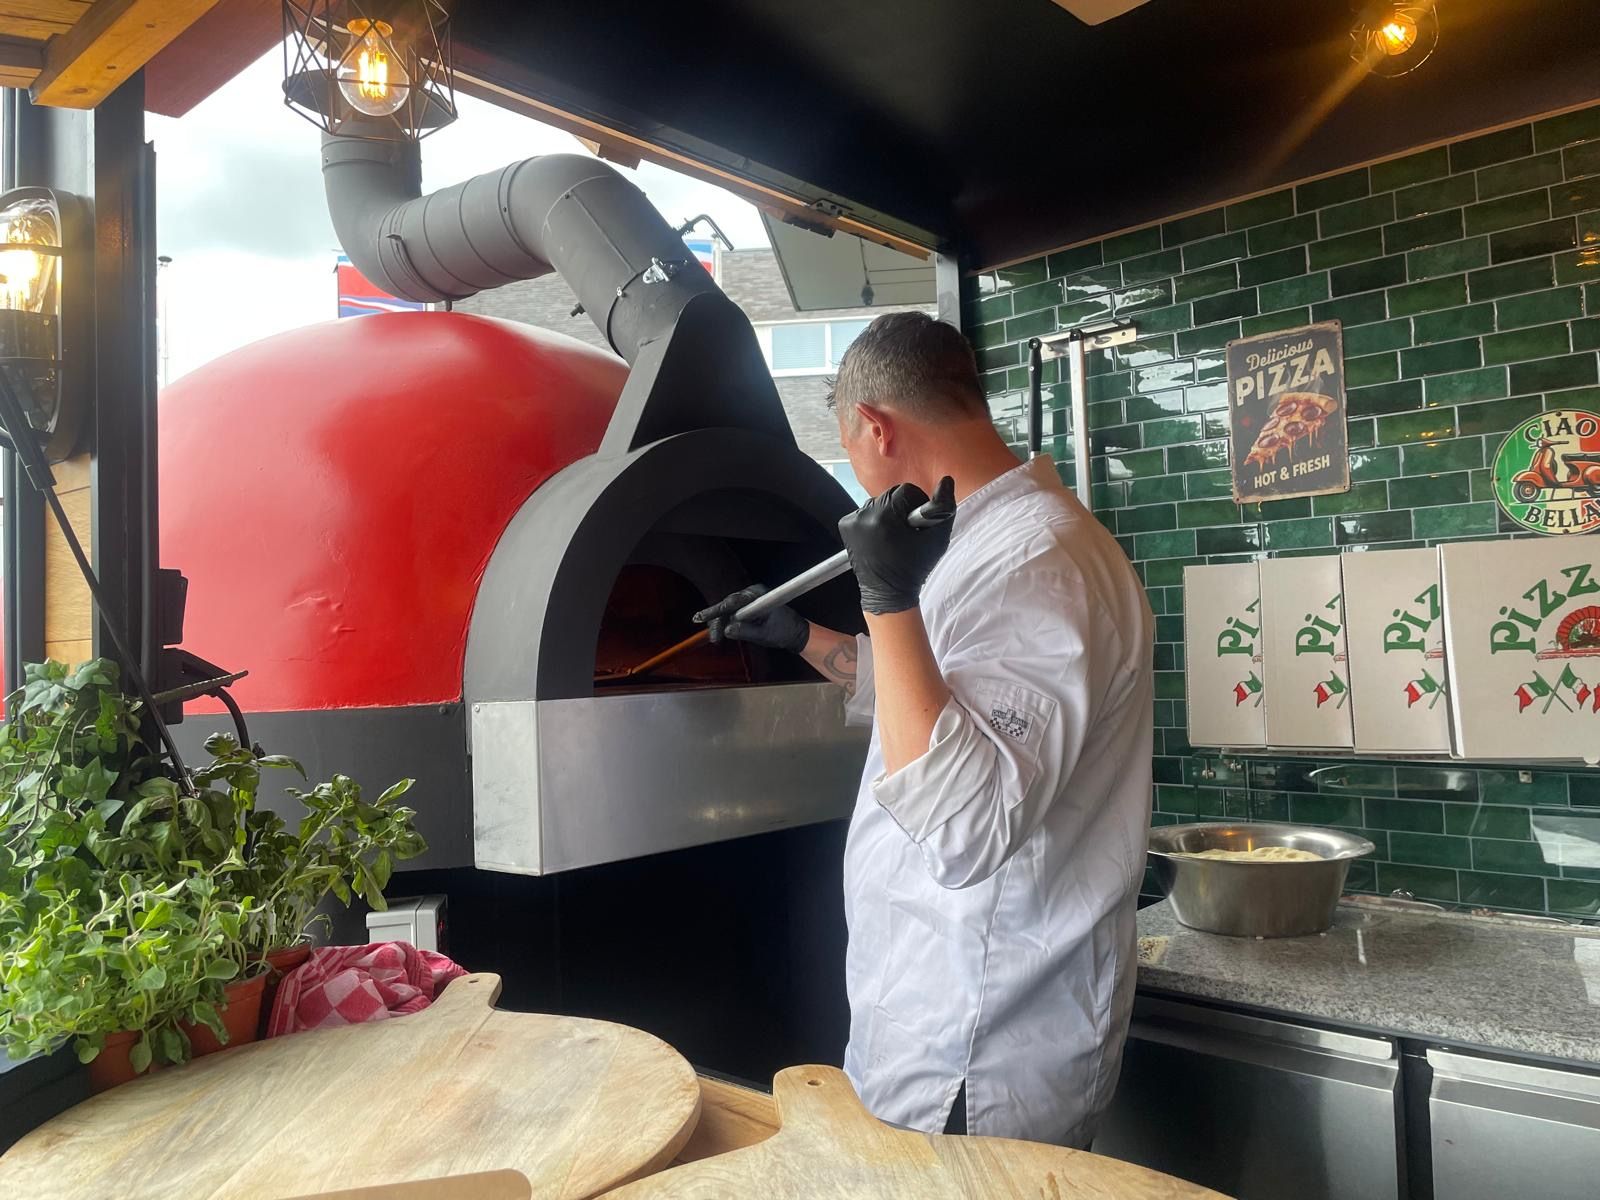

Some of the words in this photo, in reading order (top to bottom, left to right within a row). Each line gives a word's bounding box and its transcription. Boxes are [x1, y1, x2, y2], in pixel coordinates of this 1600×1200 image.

[1246, 338, 1314, 371] Delicious
[1236, 348, 1336, 407] PIZZA
[1524, 417, 1597, 442] CIAO
[1254, 471, 1277, 489] HOT
[1280, 466, 1290, 481] &
[1292, 454, 1331, 477] FRESH
[1523, 502, 1600, 527] BELLA
